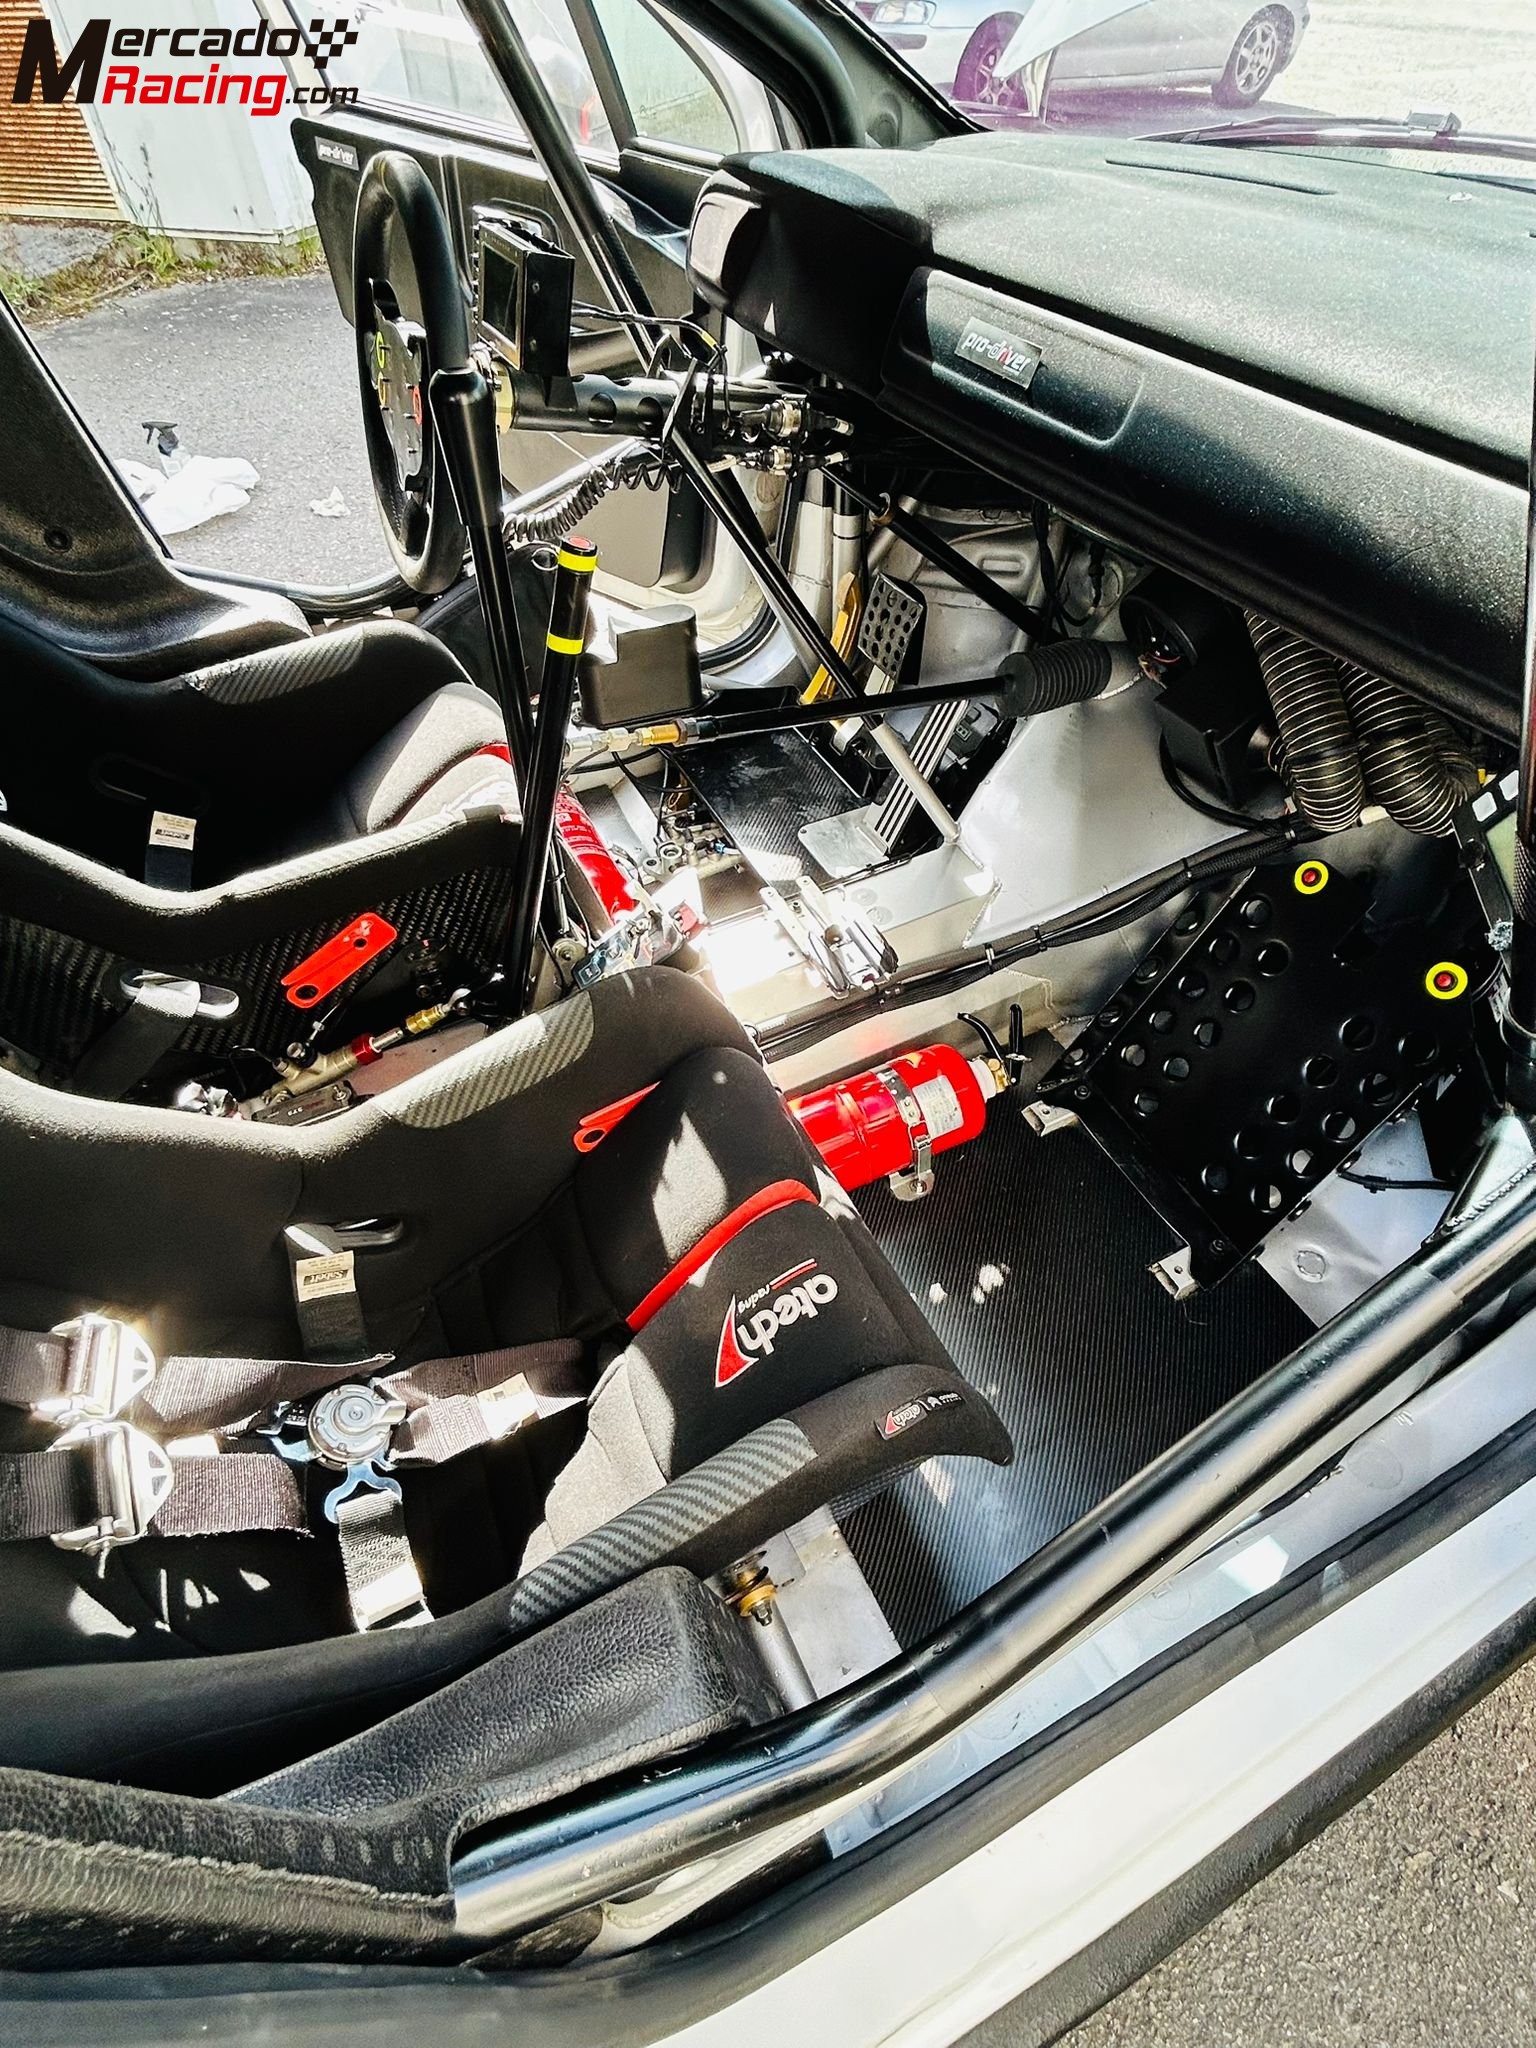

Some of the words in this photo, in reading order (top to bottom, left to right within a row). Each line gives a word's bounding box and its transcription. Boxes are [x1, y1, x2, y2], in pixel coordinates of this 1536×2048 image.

[961, 332, 1031, 374] pro-driver
[310, 1270, 344, 1283] Sabelt
[737, 1274, 838, 1355] atech
[738, 1284, 770, 1314] racing
